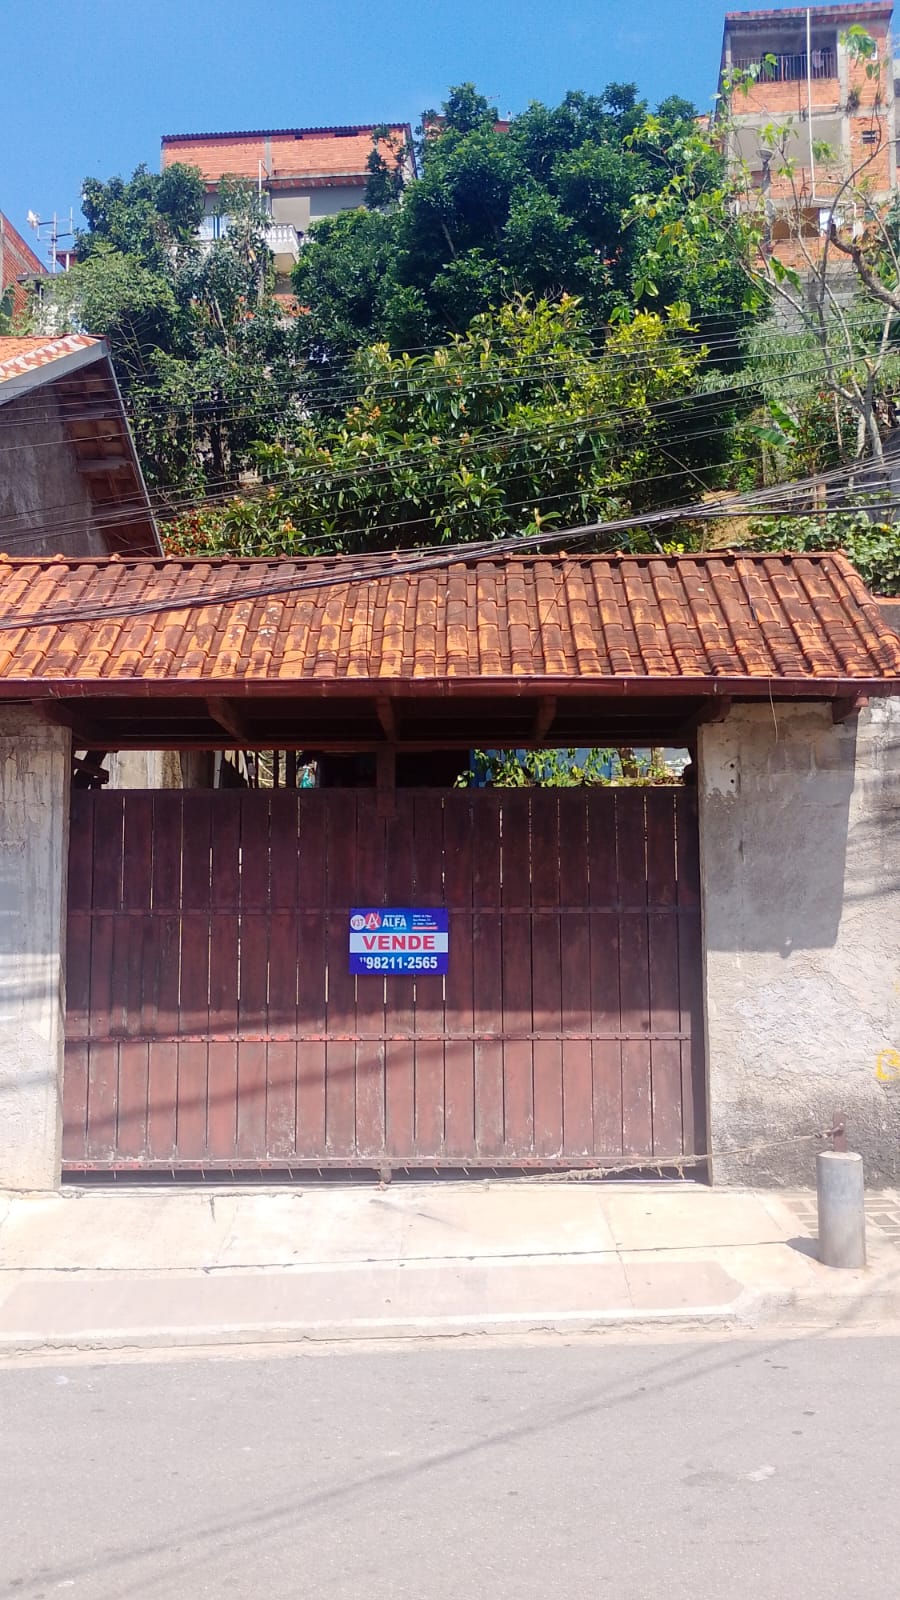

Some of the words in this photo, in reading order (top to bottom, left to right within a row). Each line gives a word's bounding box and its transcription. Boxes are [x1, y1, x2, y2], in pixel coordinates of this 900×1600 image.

[382, 917, 407, 928] ALFA
[362, 935, 435, 951] VENDE
[366, 956, 438, 969] 98211-2565
